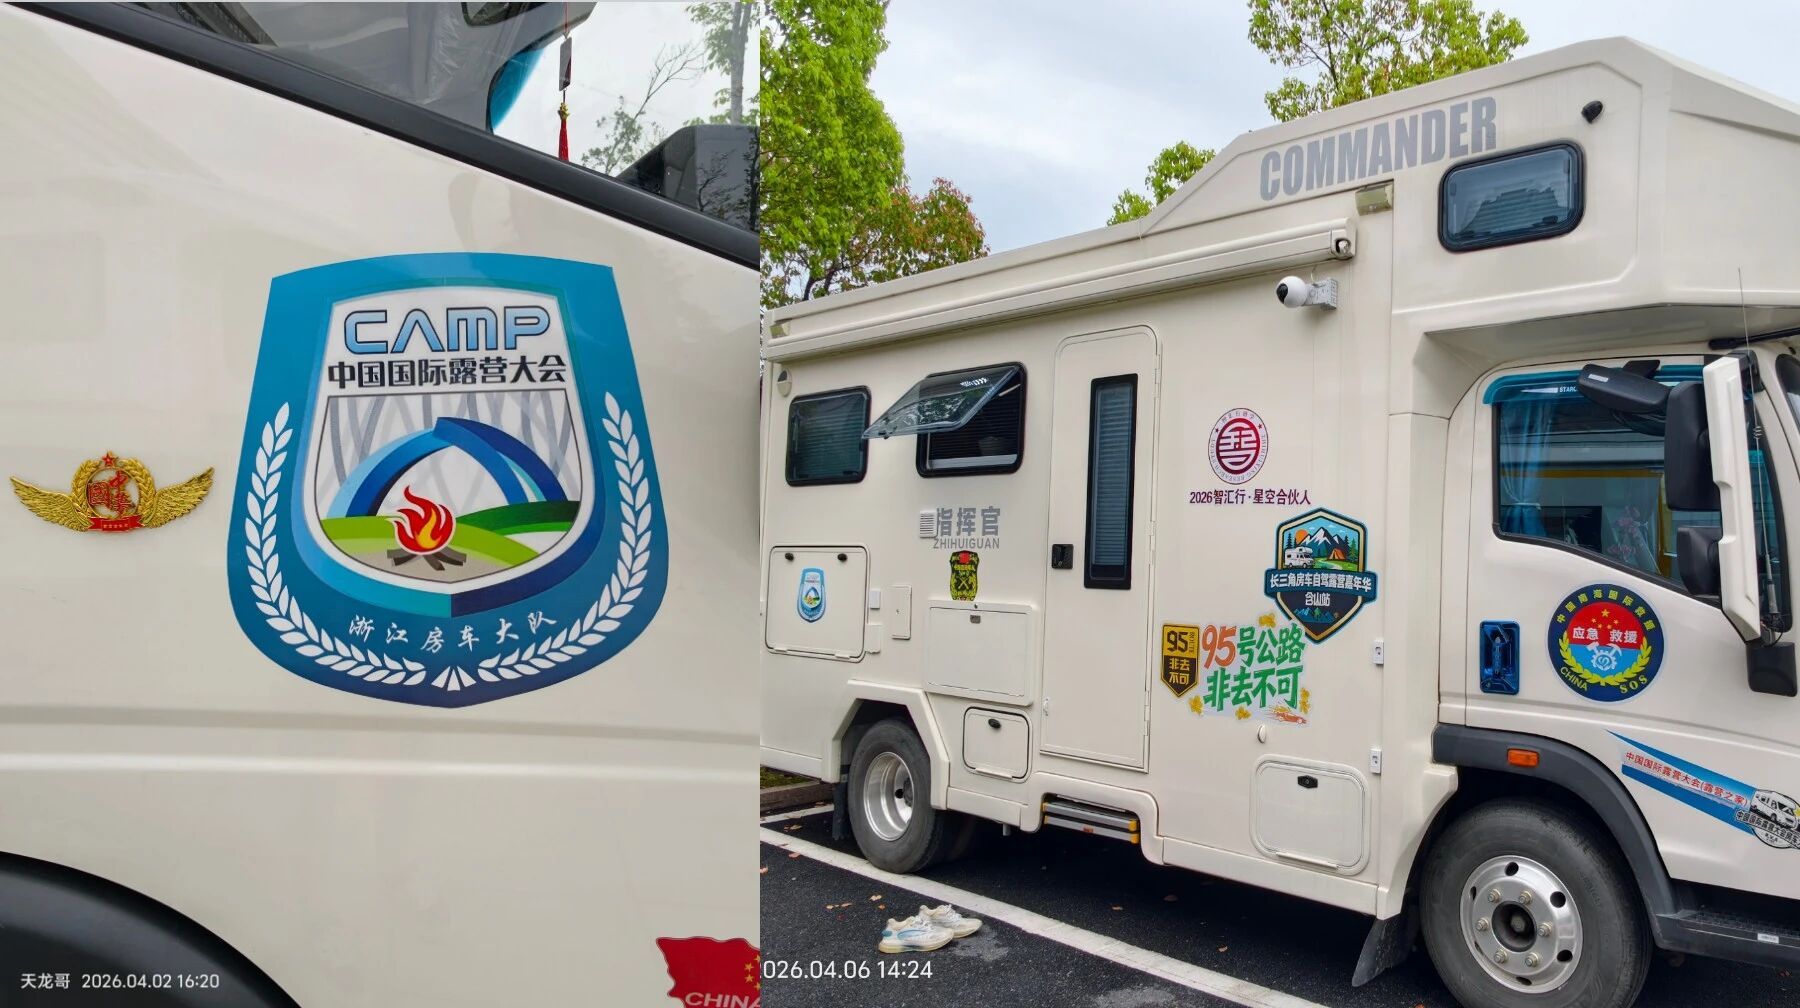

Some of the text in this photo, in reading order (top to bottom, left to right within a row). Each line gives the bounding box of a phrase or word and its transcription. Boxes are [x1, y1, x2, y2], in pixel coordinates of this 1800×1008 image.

[1260, 96, 1497, 201] COMMANDER
[344, 305, 551, 354] CAMP
[328, 355, 567, 389] 中国国际露营大会
[1190, 489, 1312, 505] 2026智汇行·星空合伙人
[933, 538, 999, 549] ZHIHUIGUAN
[1270, 572, 1372, 592] 长三角房车自驾露营嘉年华
[1305, 592, 1331, 607] 含山站
[349, 610, 557, 654] 浙江房车大队
[1167, 630, 1188, 653] 95
[1572, 626, 1638, 644] 应急 救援
[1201, 623, 1306, 669] 95号公路
[1169, 657, 1190, 671] 非去
[1169, 671, 1190, 685] 不可
[1203, 665, 1304, 712] 非去不可
[1560, 666, 1588, 691] CHINA
[1619, 674, 1648, 694] SOS
